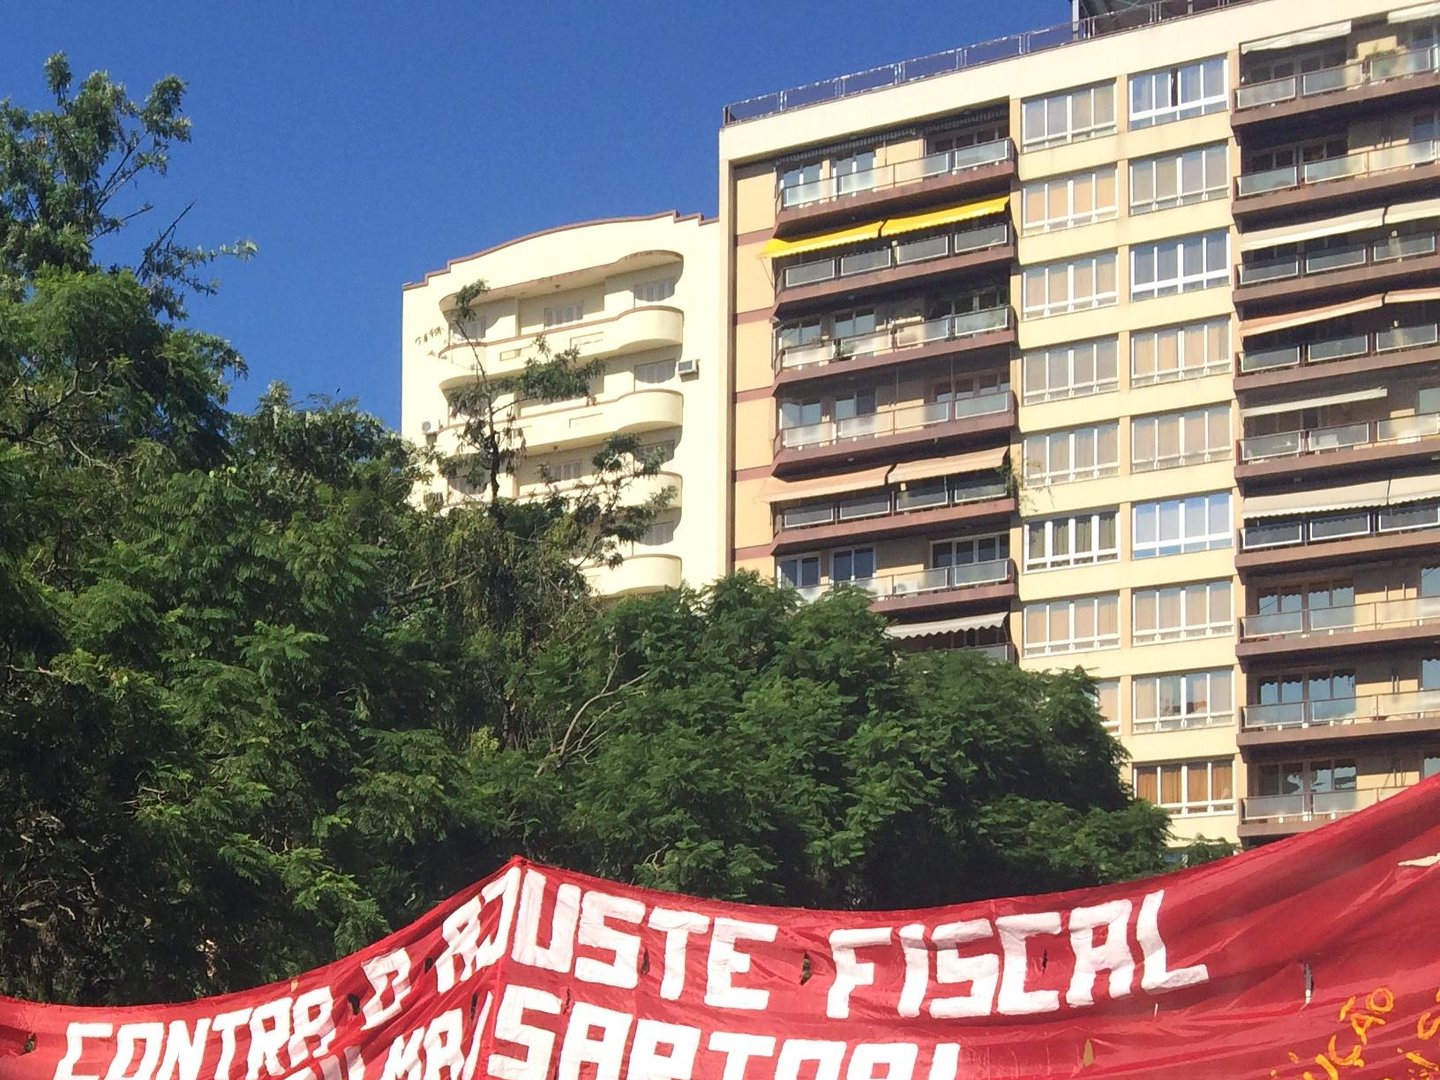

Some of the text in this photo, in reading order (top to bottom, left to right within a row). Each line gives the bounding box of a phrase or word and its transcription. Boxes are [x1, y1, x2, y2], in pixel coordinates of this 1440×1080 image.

[361, 948, 413, 1030] O
[435, 867, 777, 1010] AJUSTE
[827, 890, 1208, 1019] FISCAL
